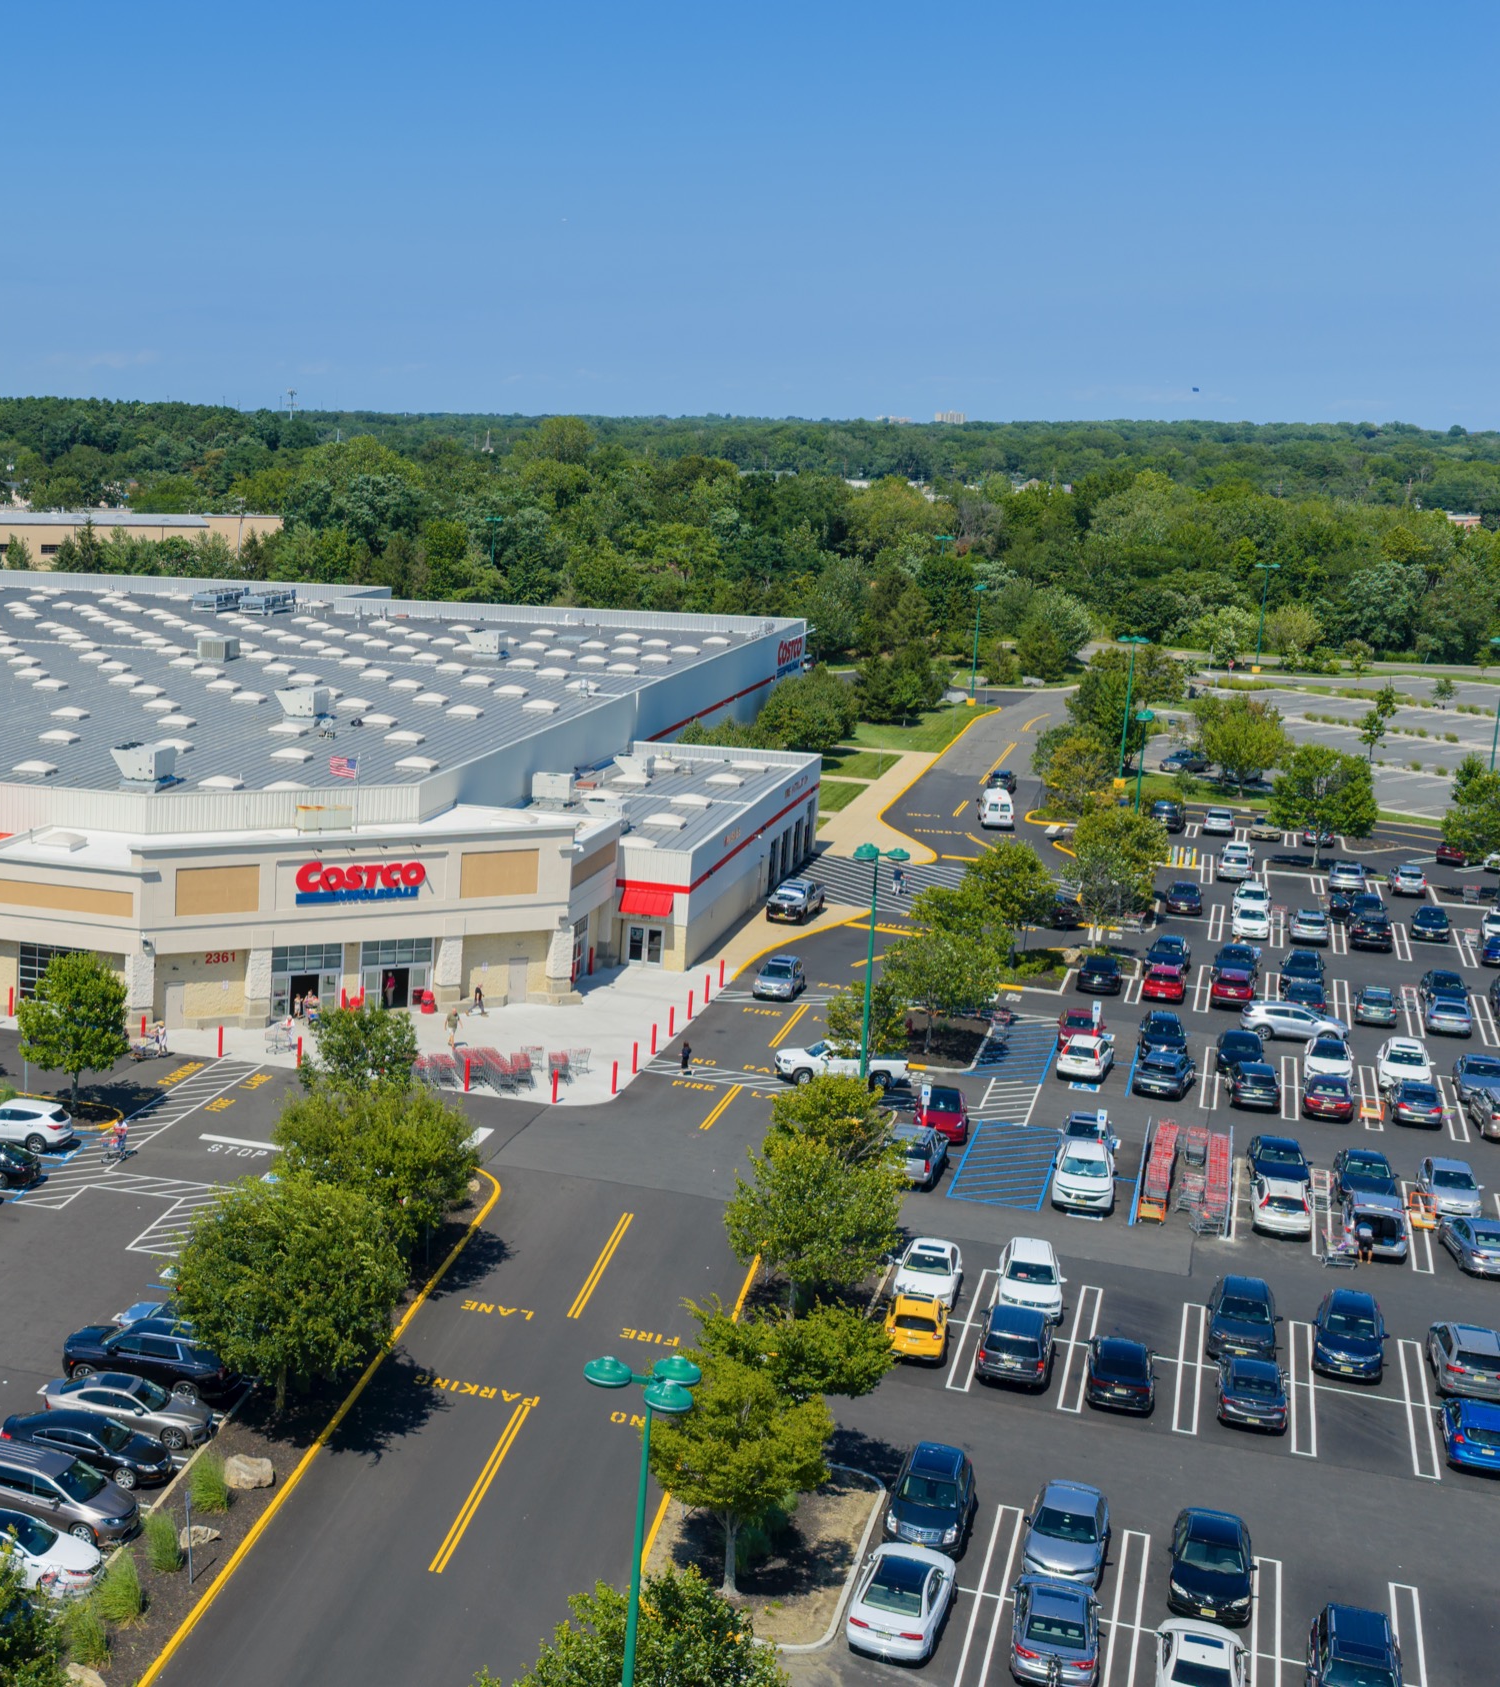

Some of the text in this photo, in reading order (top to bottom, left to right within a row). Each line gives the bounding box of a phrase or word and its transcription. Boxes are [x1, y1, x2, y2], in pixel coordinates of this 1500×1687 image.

[778, 638, 802, 665] COSTCO
[295, 861, 426, 893] COSTCO
[205, 951, 237, 964] 2361
[743, 1007, 784, 1017] FIRE
[156, 1061, 205, 1086] PARKING
[691, 1057, 717, 1066] NO
[204, 1074, 273, 1113] FIRE LANE
[671, 1080, 717, 1092] FIRE
[206, 1143, 268, 1159] STOP
[460, 1299, 681, 1347] FIRE LANE
[413, 1374, 647, 1428] NO PARKING
